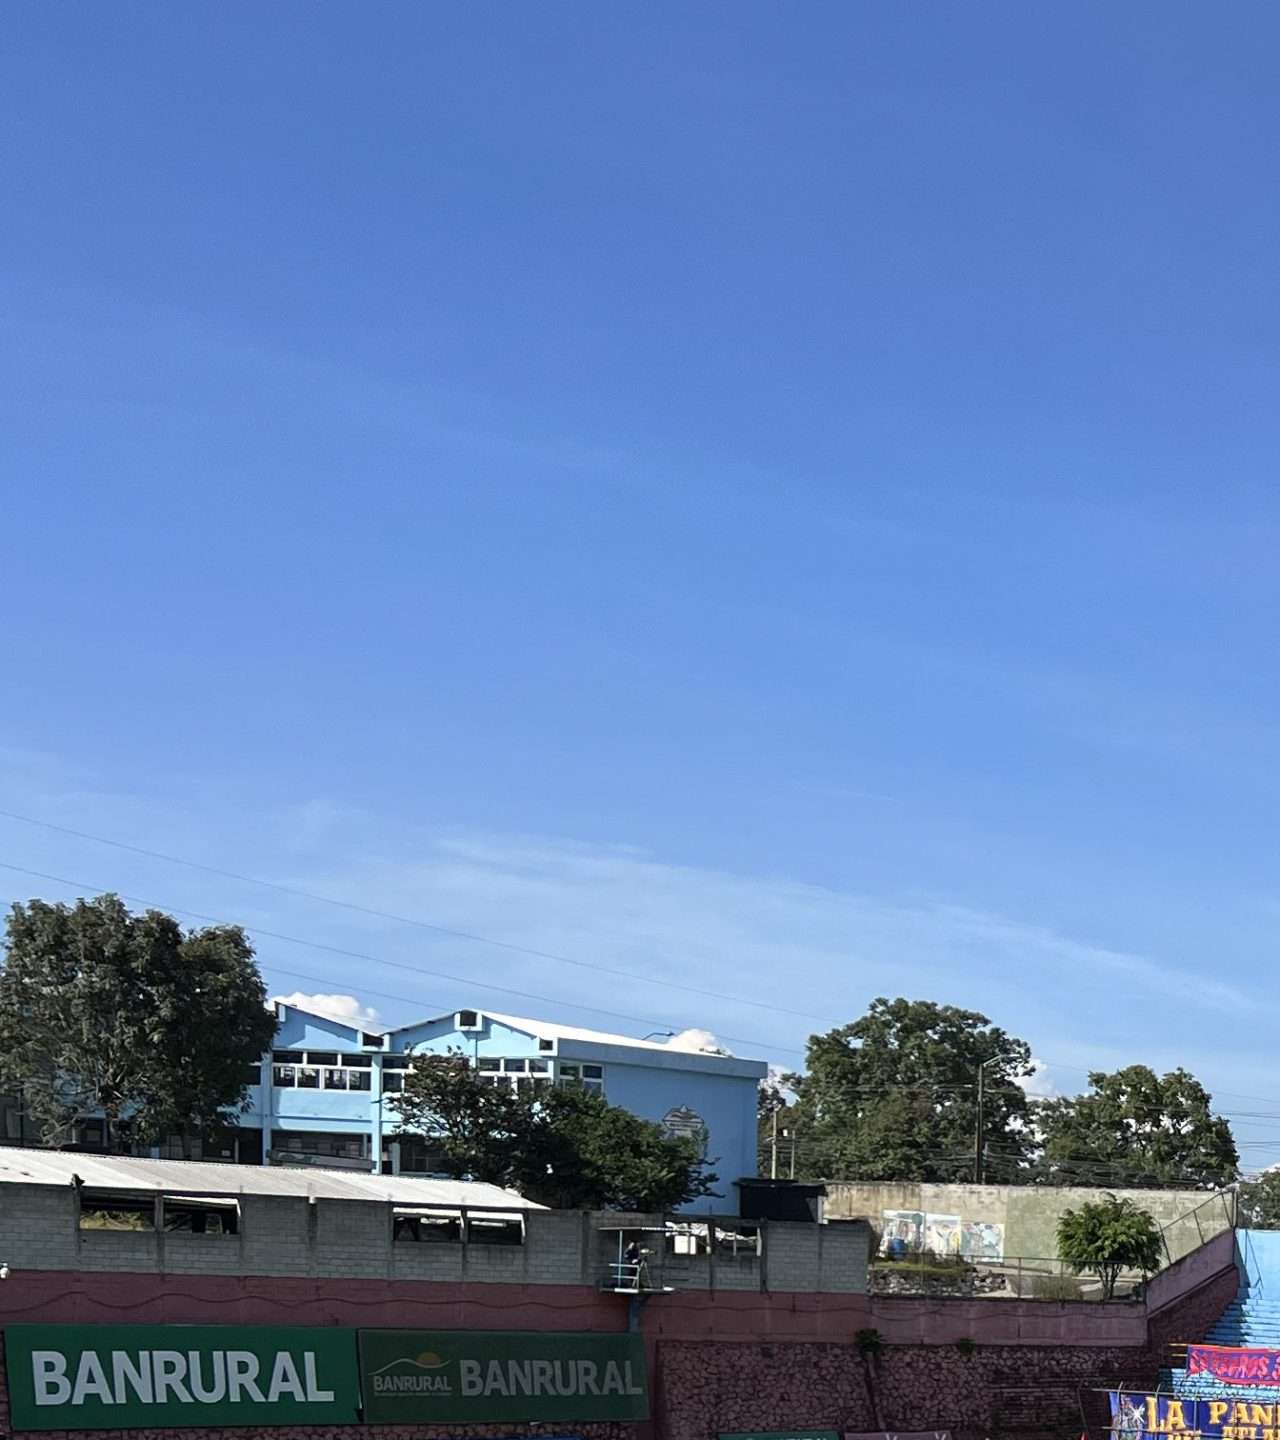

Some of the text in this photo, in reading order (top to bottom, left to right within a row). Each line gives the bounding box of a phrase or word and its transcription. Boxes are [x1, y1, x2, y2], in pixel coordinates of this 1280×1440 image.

[31, 1350, 335, 1406] BANRURAL
[373, 1375, 453, 1393] BANRURAL
[459, 1359, 644, 1397] BANRURAL
[1145, 1395, 1186, 1433] LA
